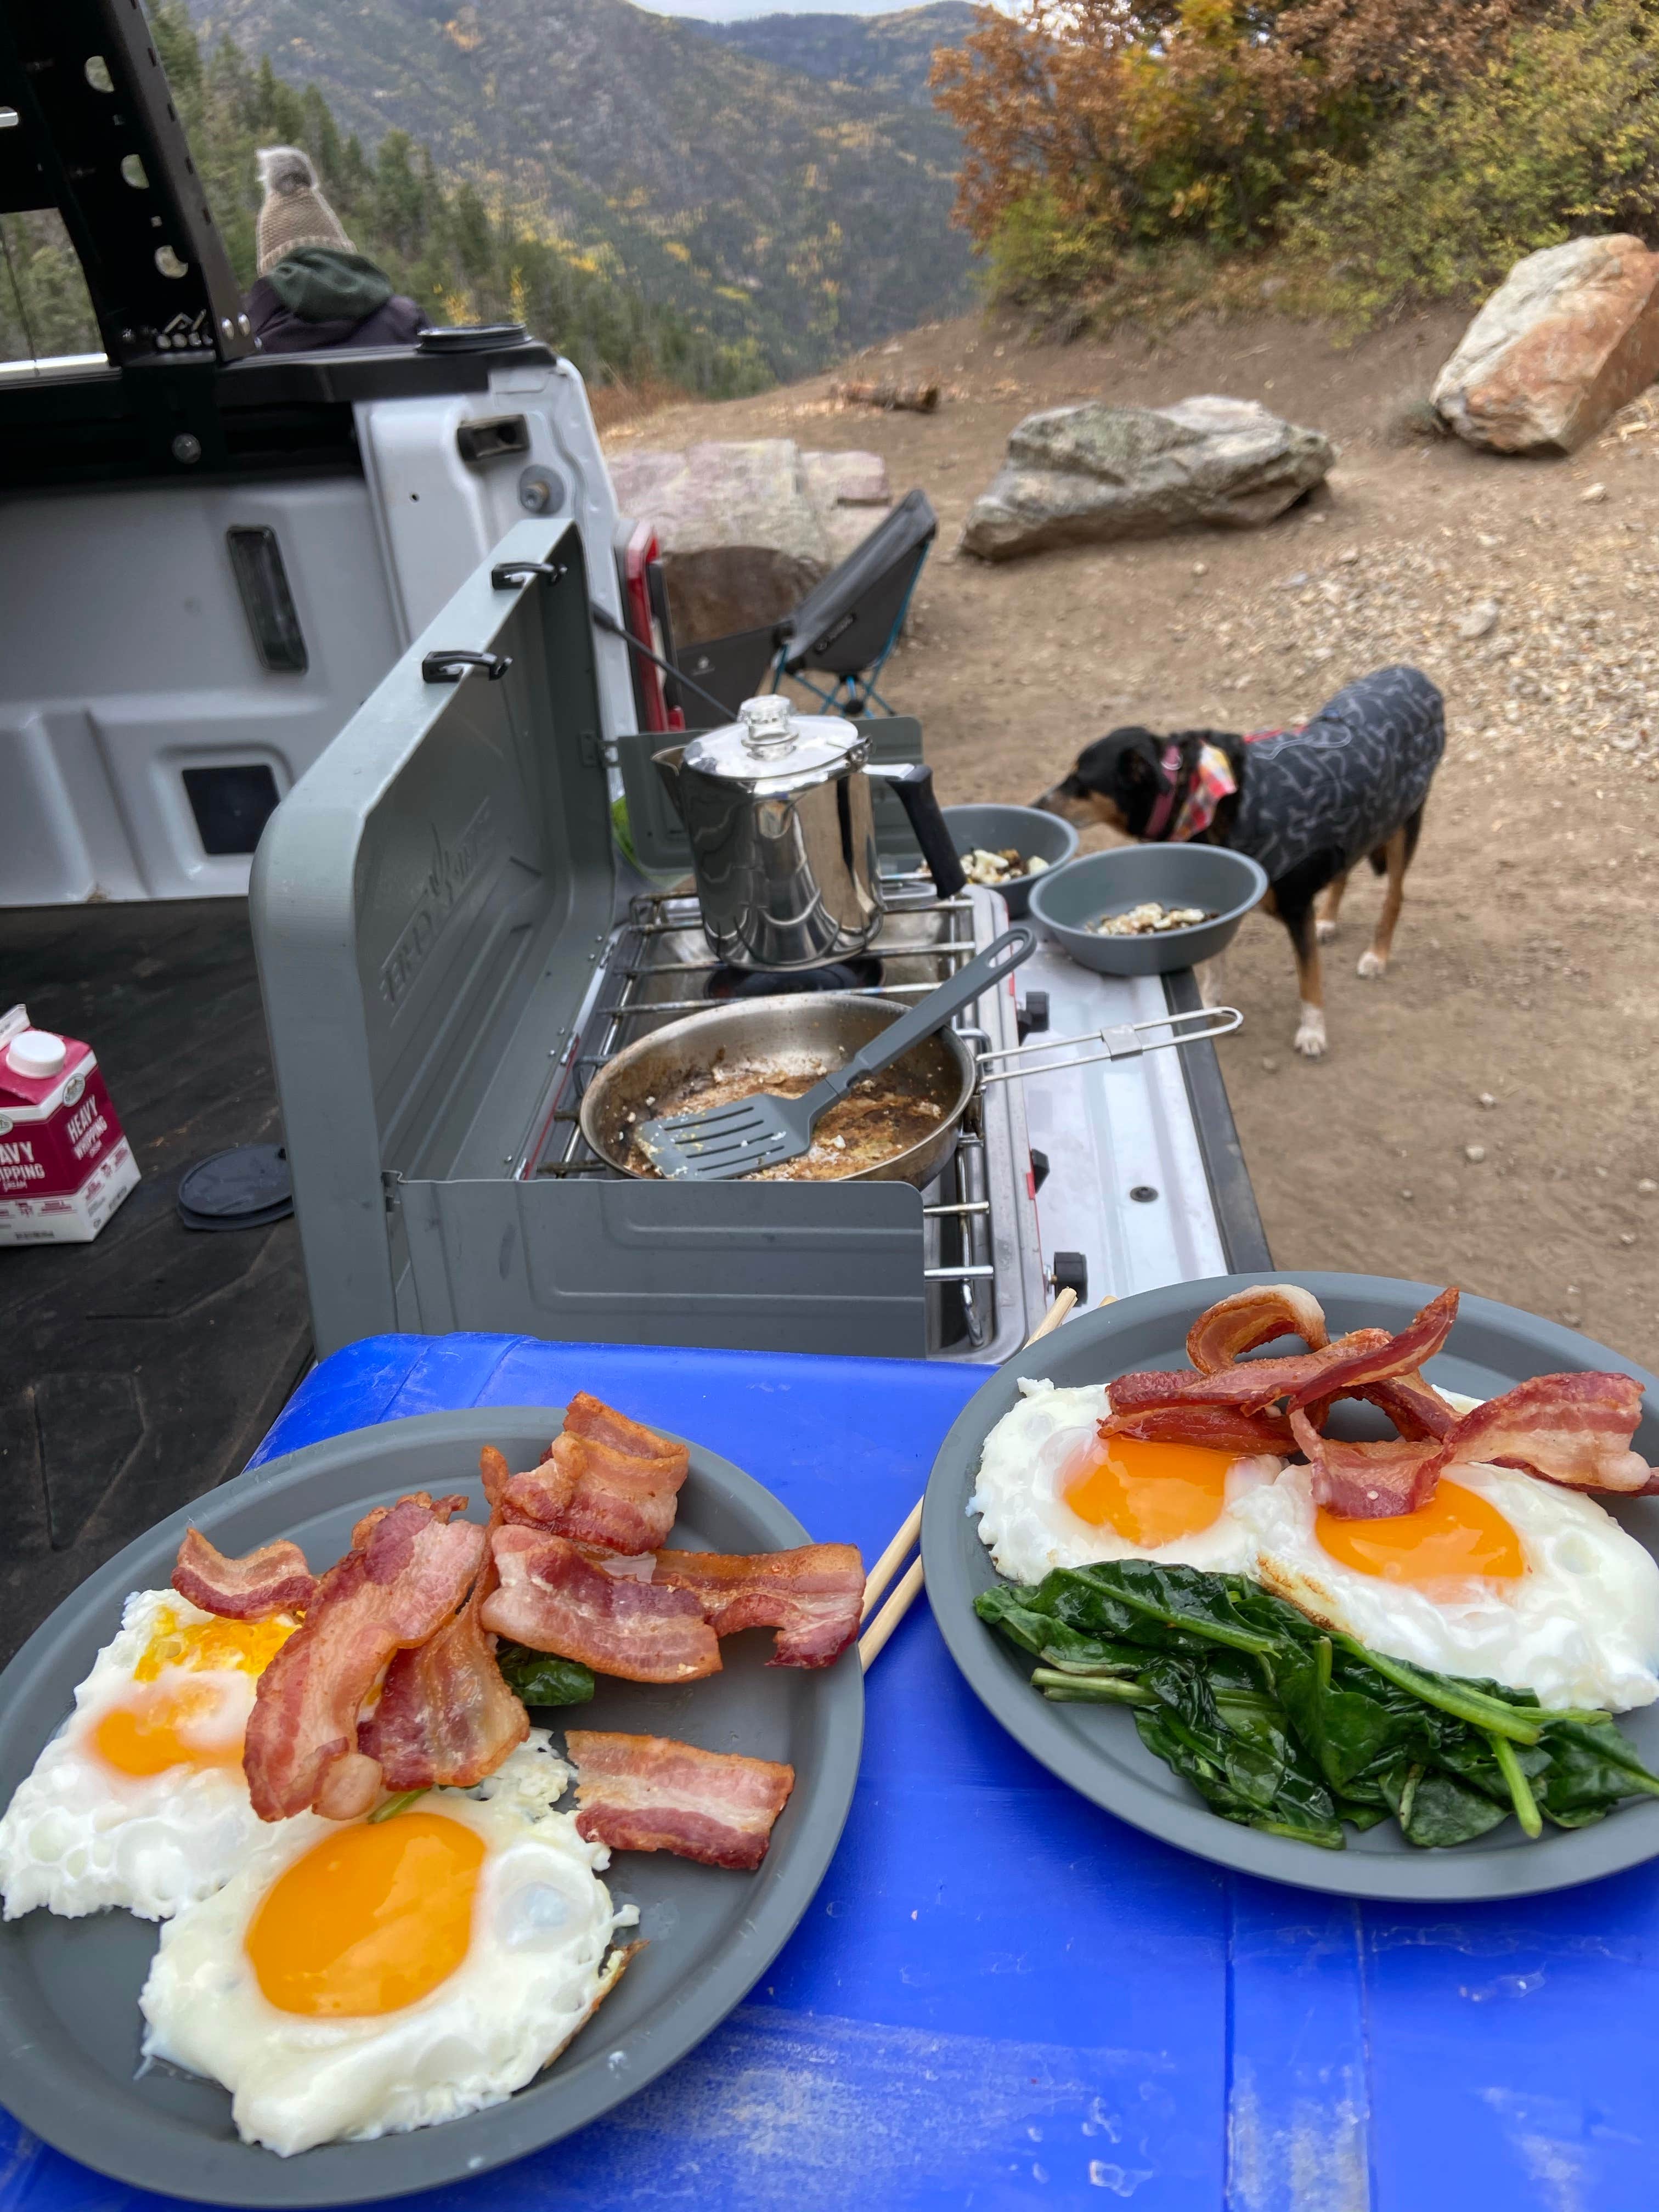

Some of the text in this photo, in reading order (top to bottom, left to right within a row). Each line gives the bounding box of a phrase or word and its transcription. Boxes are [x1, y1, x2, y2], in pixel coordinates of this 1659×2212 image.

[67, 1094, 98, 1144] HEAVY
[0, 1141, 35, 1165] AVY
[0, 1163, 45, 1182] IPPING
